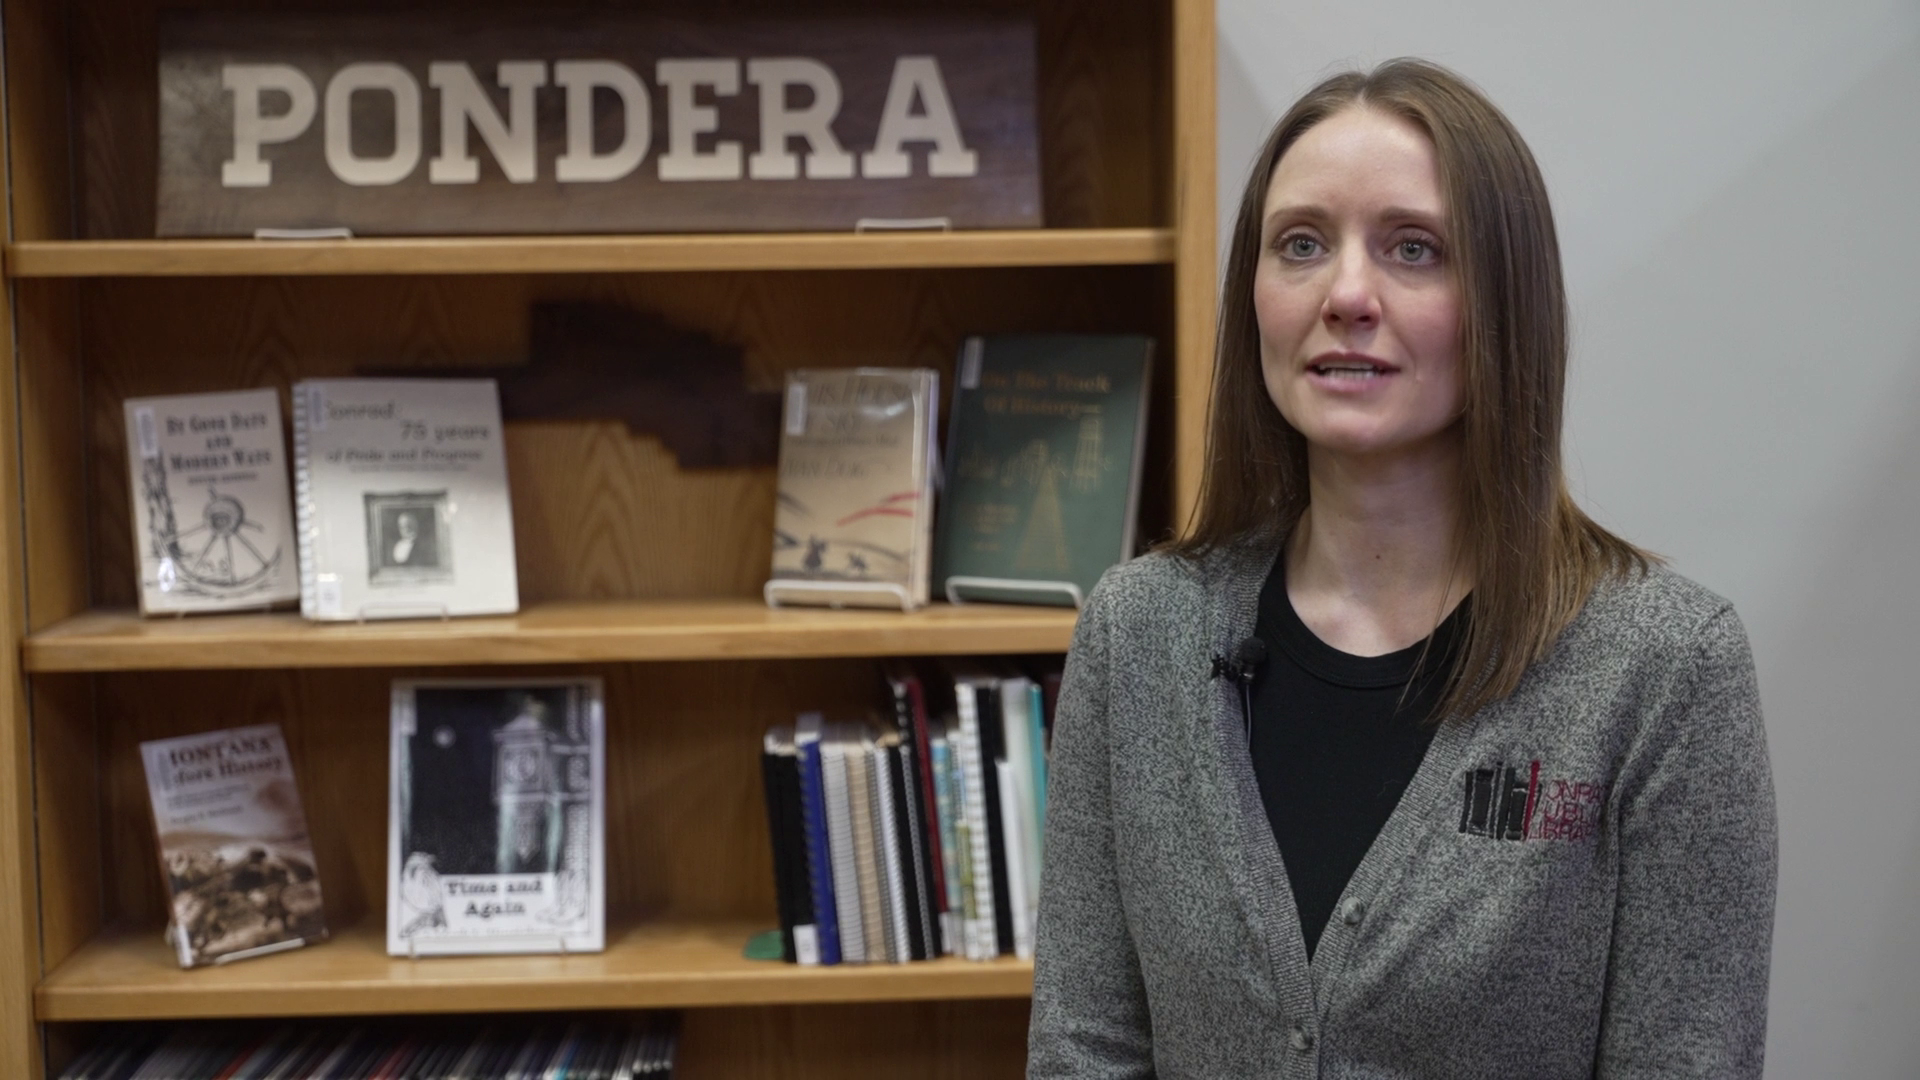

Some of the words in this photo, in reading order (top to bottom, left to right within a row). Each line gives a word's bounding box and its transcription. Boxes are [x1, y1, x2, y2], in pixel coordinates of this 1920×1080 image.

[221, 54, 979, 188] PONDERA
[434, 424, 491, 444] years
[387, 447, 418, 462] and
[218, 755, 283, 779] History
[446, 880, 498, 896] Time
[506, 879, 543, 896] and
[464, 901, 526, 920] Again
